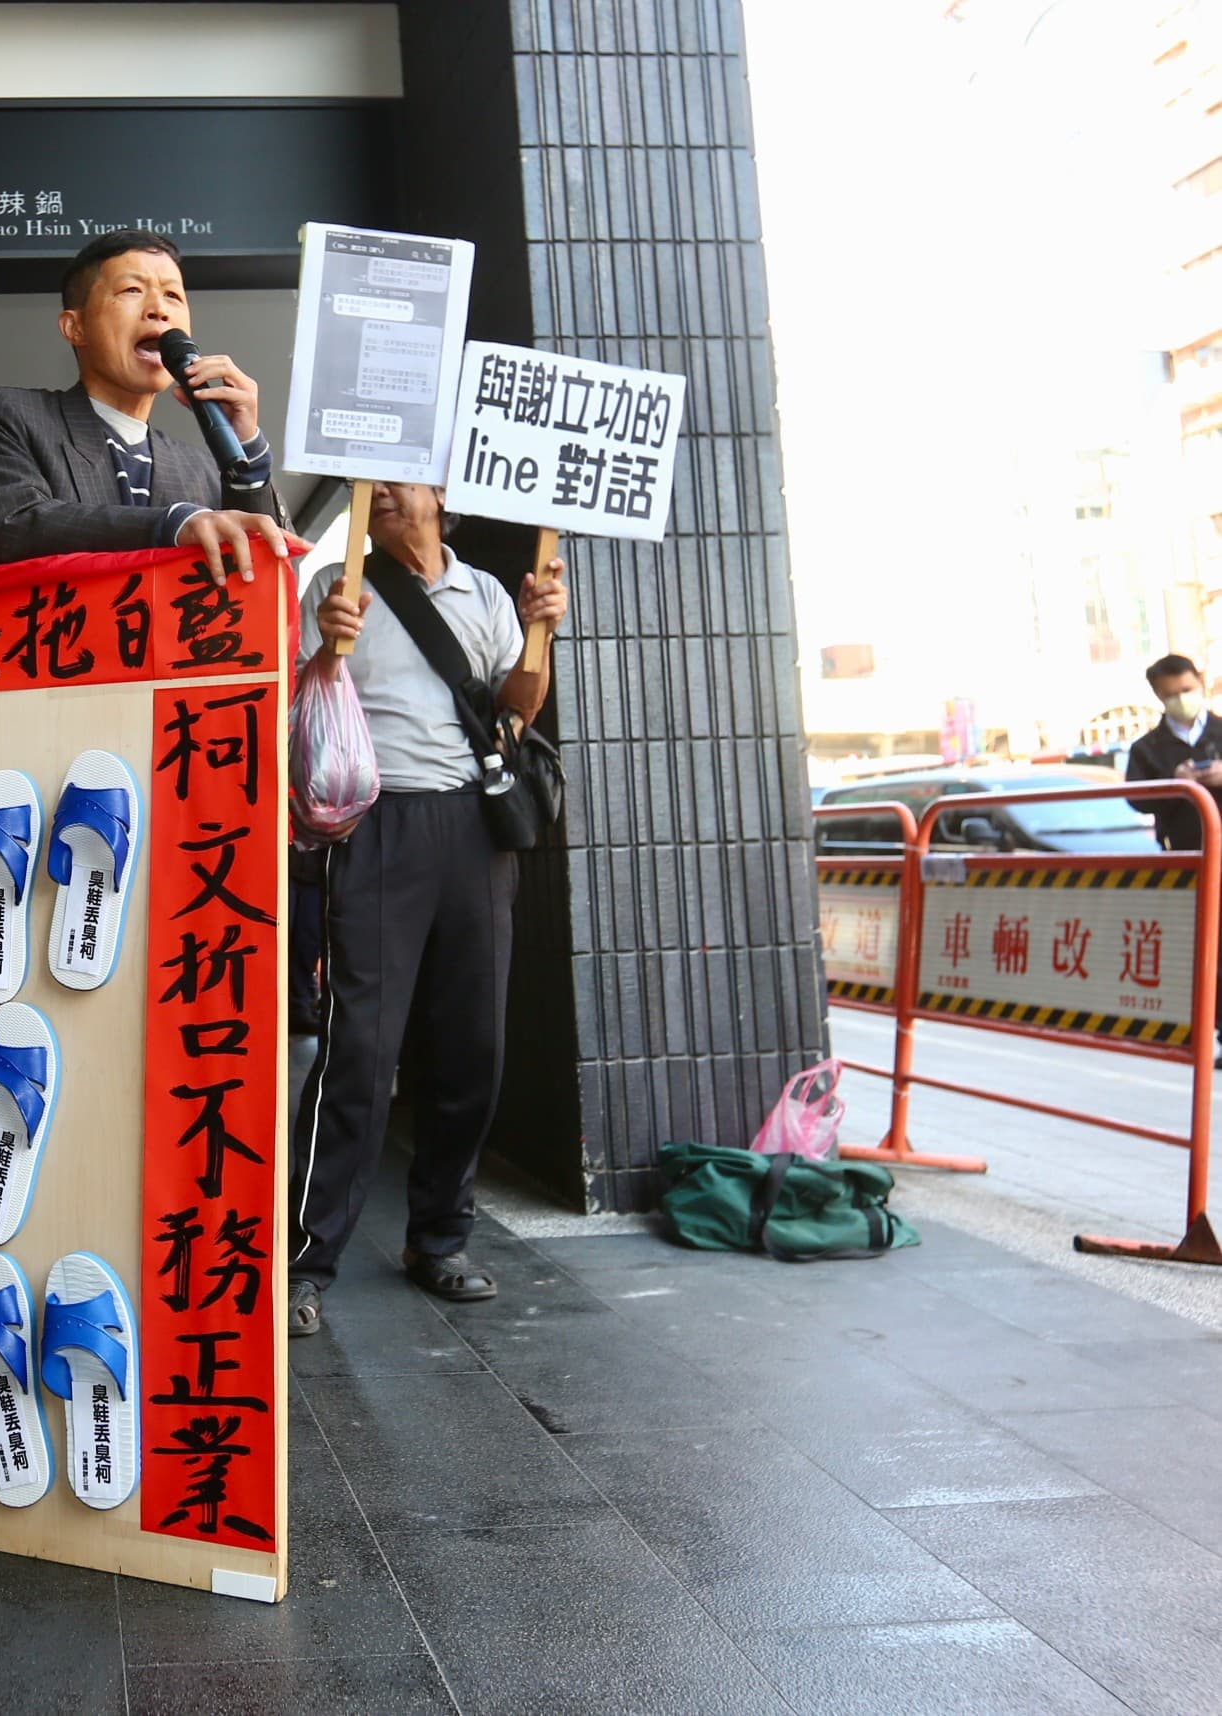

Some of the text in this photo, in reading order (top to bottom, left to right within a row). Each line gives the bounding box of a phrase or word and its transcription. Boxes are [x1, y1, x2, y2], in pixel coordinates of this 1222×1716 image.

[25, 219, 72, 236] Hsin
[136, 218, 174, 235] Hot
[180, 218, 213, 235] Pot
[475, 353, 671, 449] 與謝立功的
[463, 427, 659, 519] line 對話
[79, 870, 104, 960] 臭鞋丟臭柯
[941, 912, 1164, 988] 車輛改道
[149, 688, 279, 1541] 柯文哲不務正業
[92, 1384, 112, 1484] 臭鞋丟臭柯
